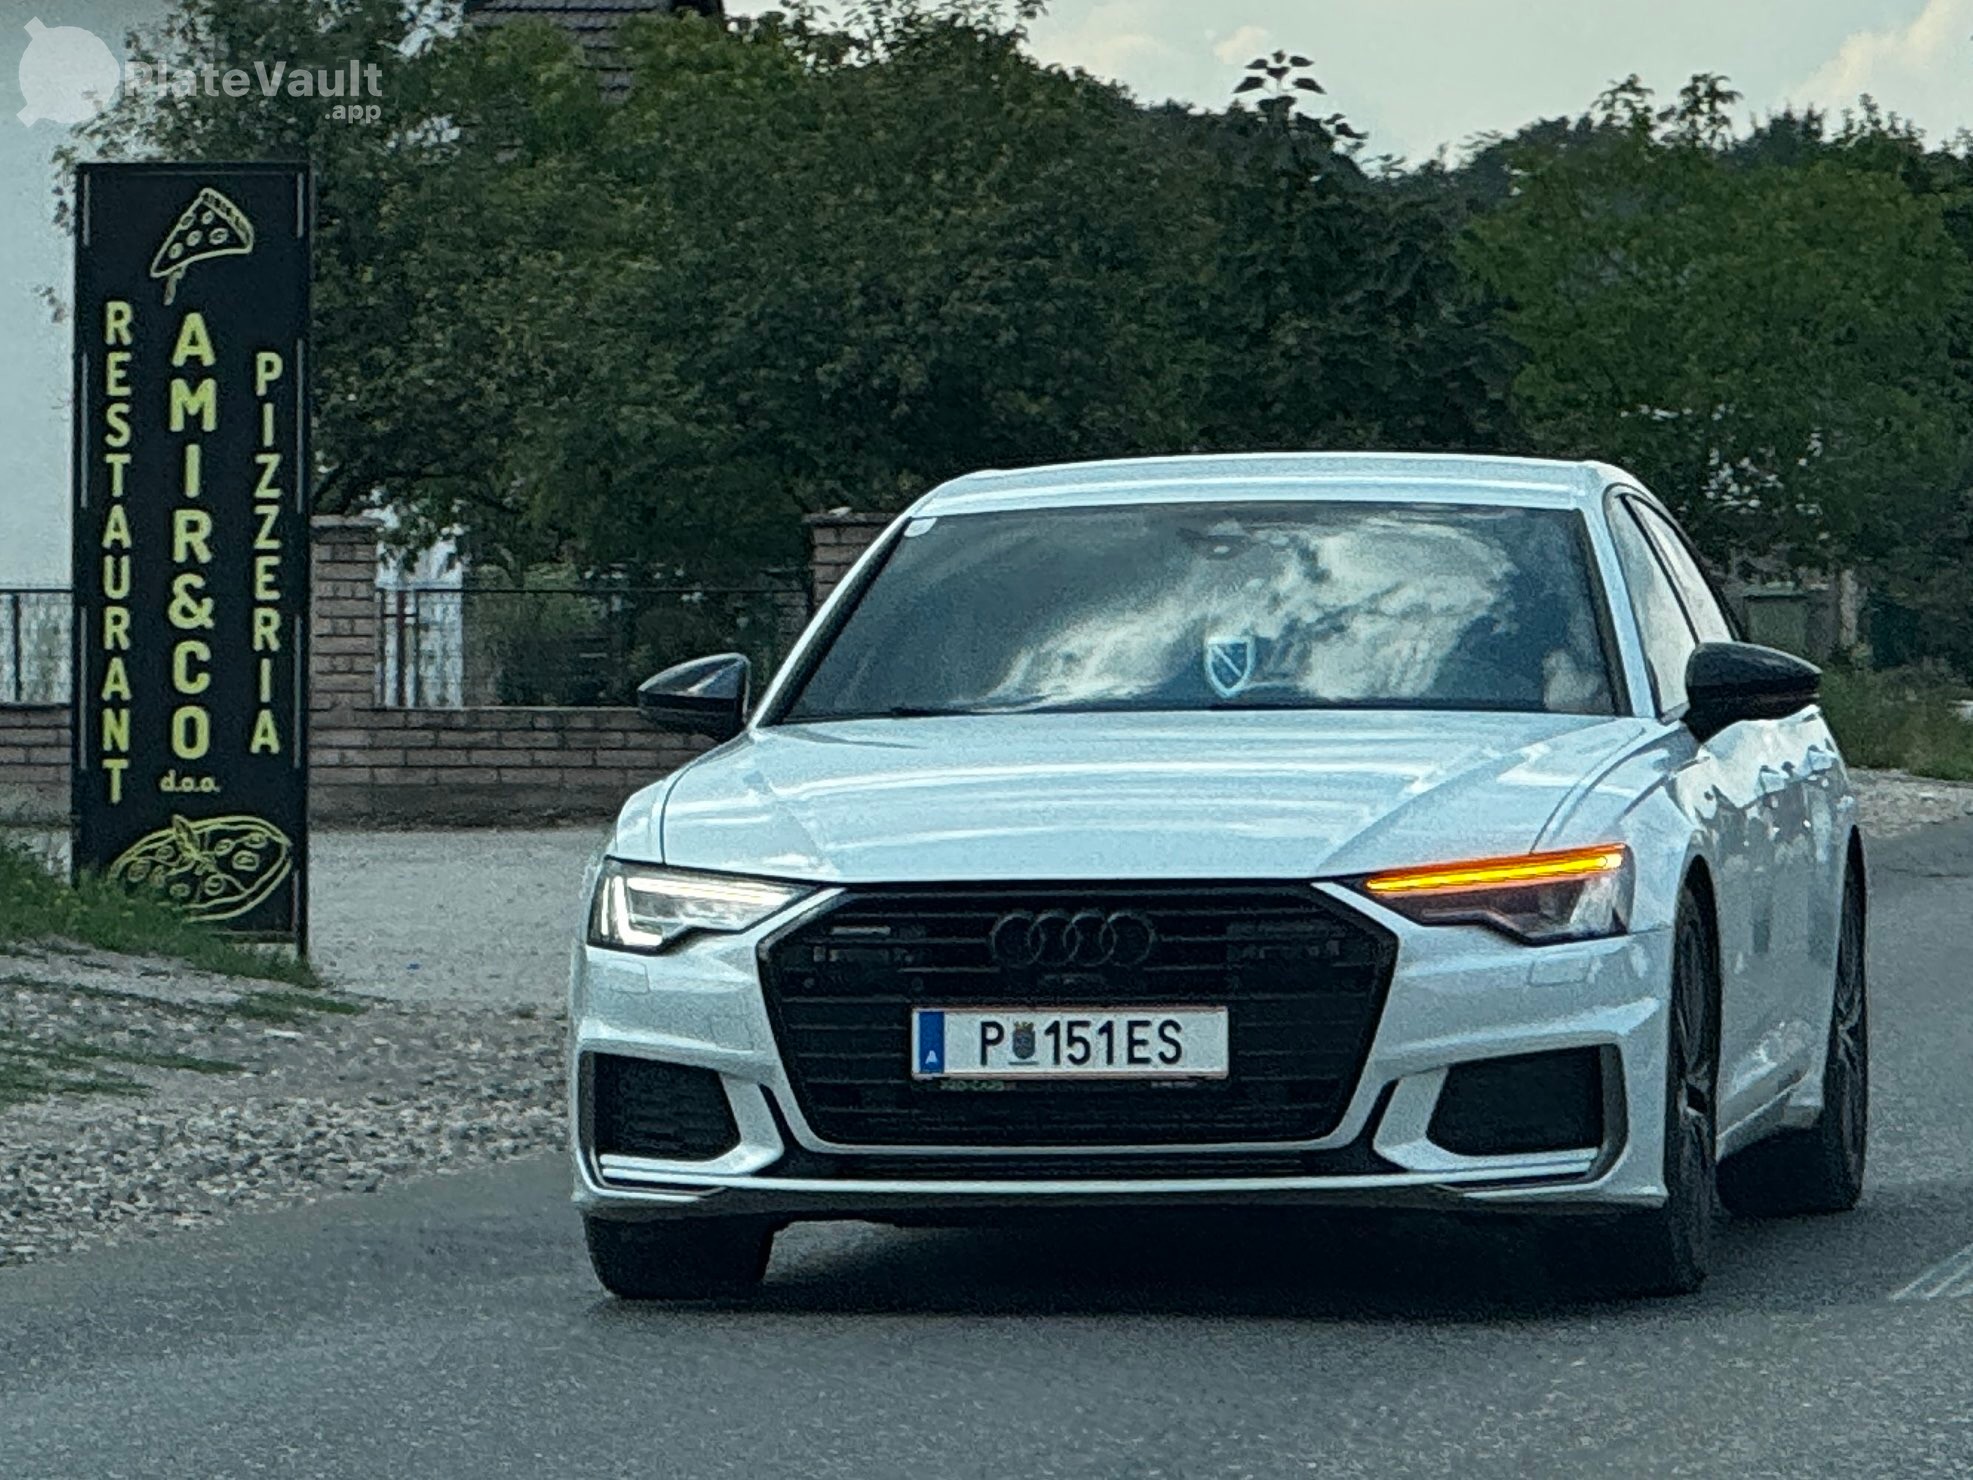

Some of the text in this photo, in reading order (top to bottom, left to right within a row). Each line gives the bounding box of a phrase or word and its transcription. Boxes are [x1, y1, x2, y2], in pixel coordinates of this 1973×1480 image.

[102, 301, 133, 803] RESTAURANT
[168, 312, 217, 760] AMIR&CO
[250, 351, 283, 754] PIZZERIA
[979, 1020, 1005, 1066] P
